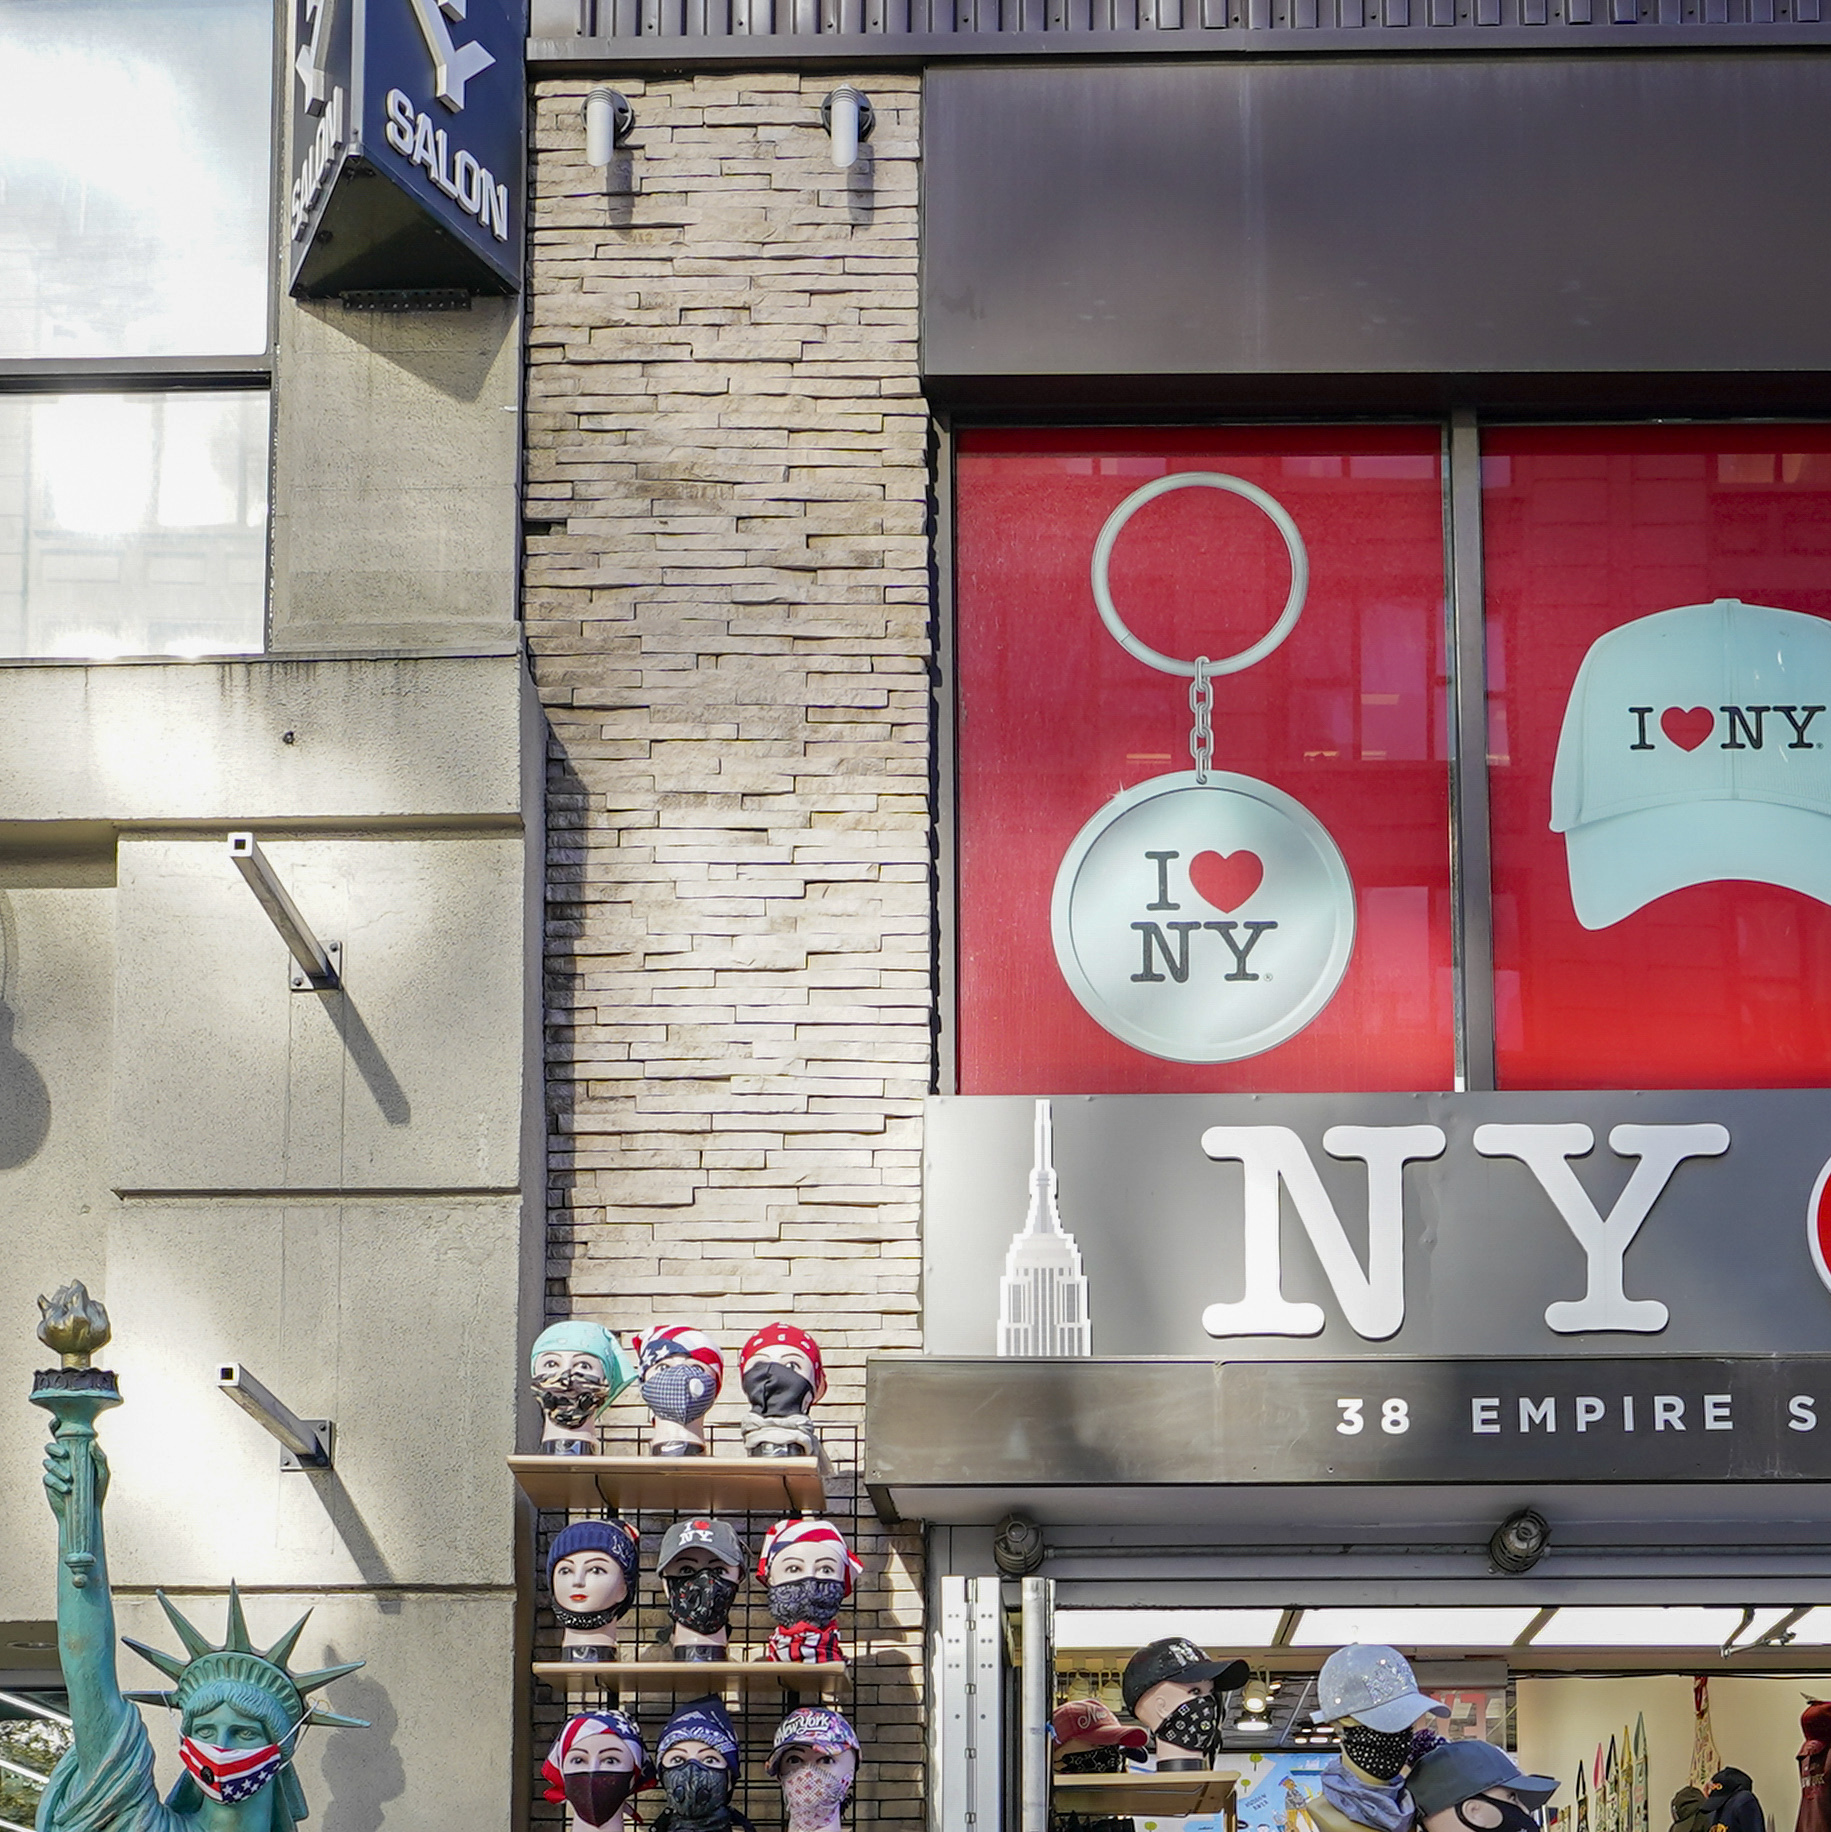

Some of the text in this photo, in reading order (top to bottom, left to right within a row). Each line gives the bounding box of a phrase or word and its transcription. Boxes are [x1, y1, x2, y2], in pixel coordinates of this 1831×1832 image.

[385, 88, 509, 243] SALON
[1629, 705, 1826, 751] I NY
[1144, 849, 1180, 911] I
[1130, 921, 1278, 983] NY
[1201, 1123, 1731, 1339] NY
[1337, 1398, 1410, 1435] 38
[1473, 1395, 1734, 1433] EMPIRE
[678, 1530, 714, 1546] NY
